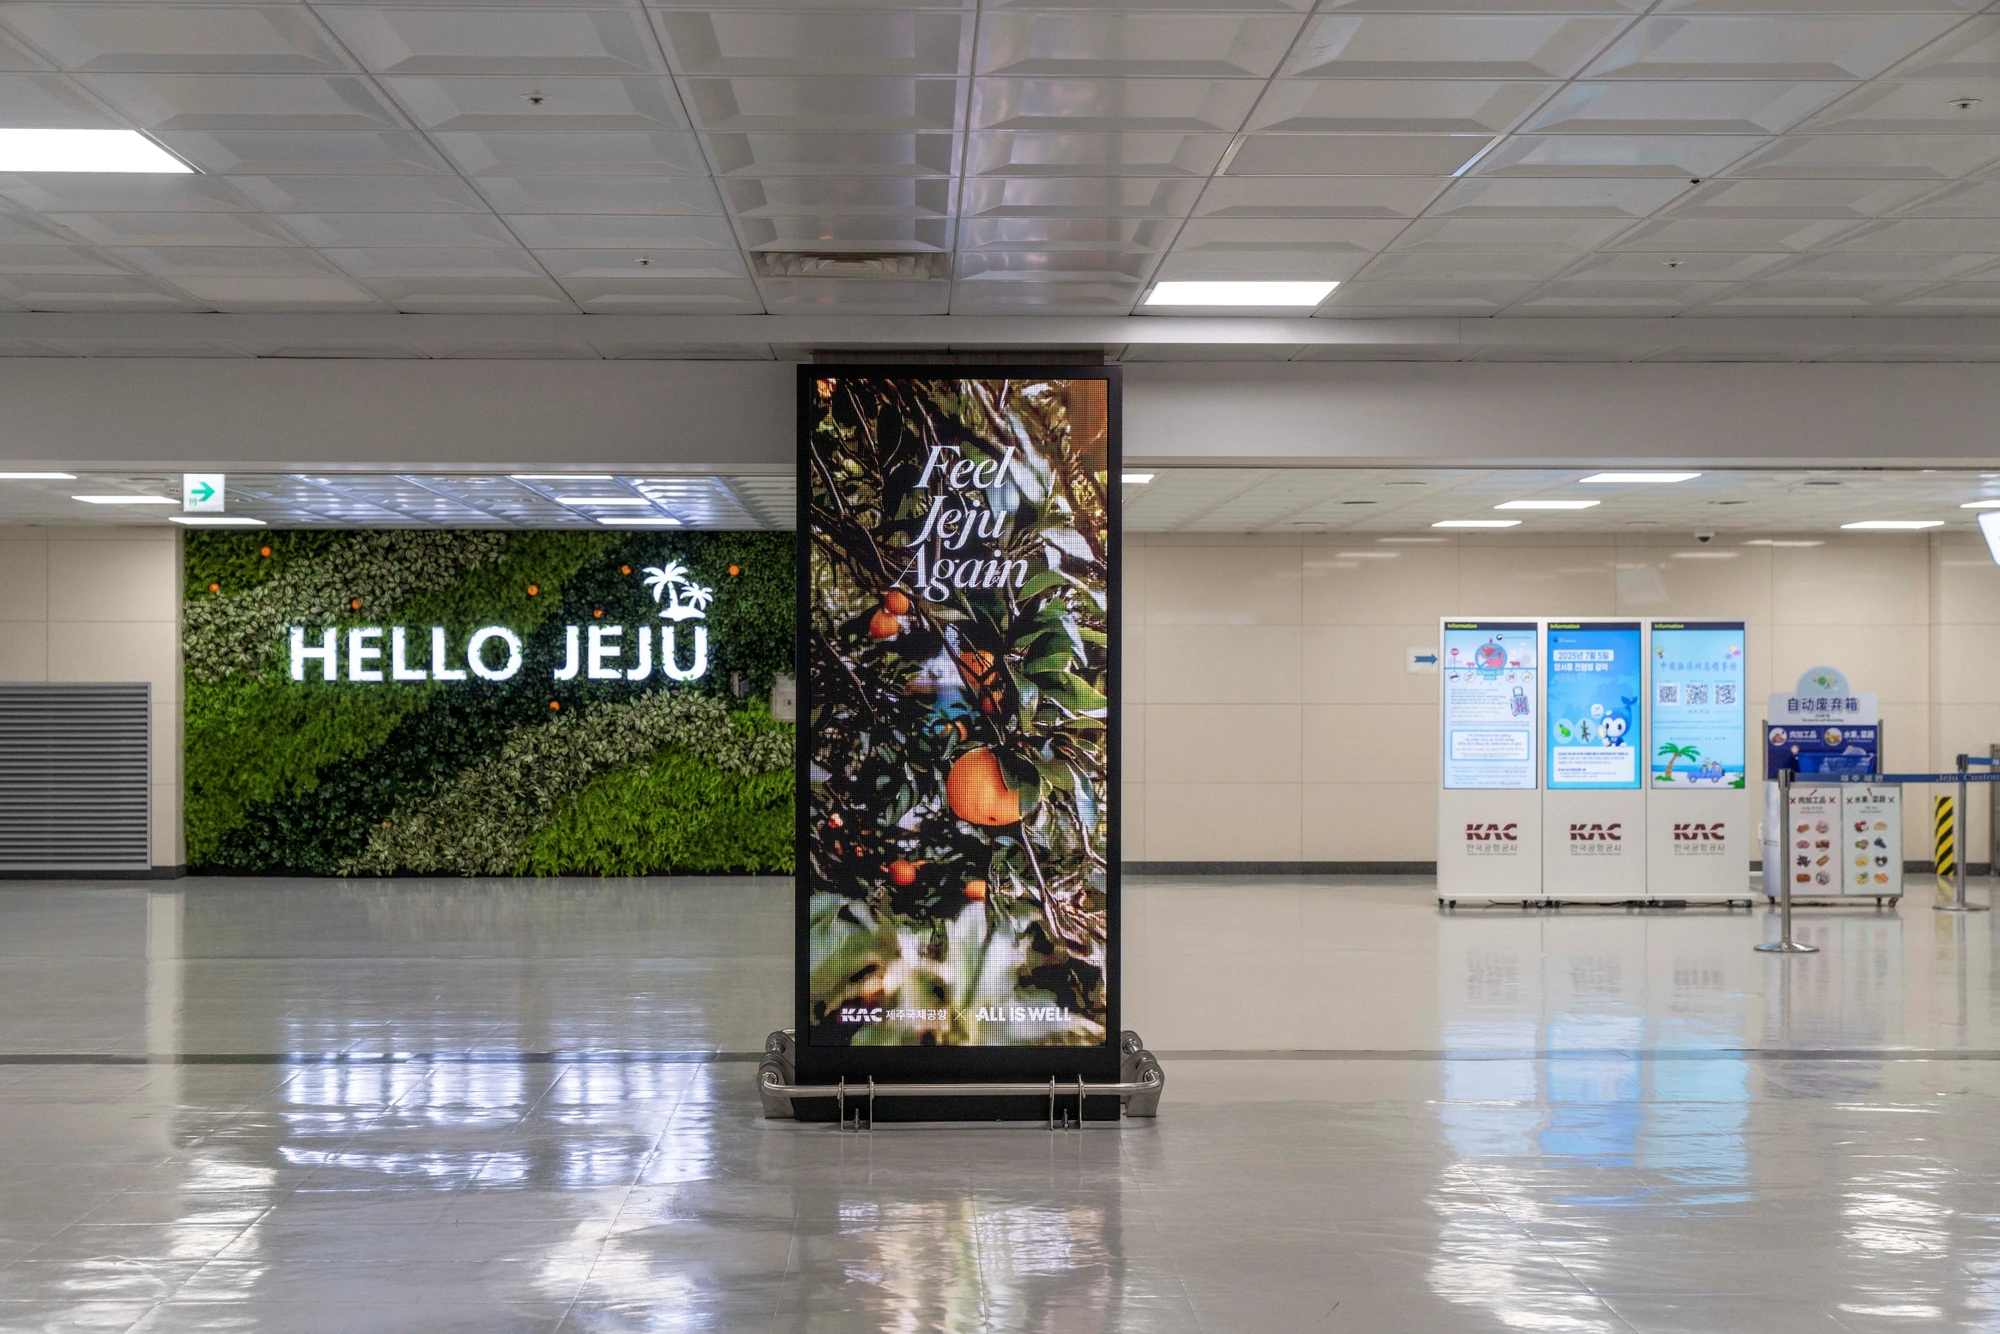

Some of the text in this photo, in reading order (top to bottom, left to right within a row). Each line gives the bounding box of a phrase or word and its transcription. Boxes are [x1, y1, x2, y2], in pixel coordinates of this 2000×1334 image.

[913, 445, 1016, 489] Feel
[906, 495, 1007, 550] Jeju
[890, 544, 1029, 602] Again
[290, 625, 708, 682] HELLO JEJU
[1558, 651, 1609, 660] 2025년 7월 5일
[1787, 697, 1858, 712] 自动废弃箱
[1936, 774, 1958, 782] Jeju
[1798, 796, 1826, 804] 肉加工品
[1465, 823, 1518, 841] KAC
[1569, 823, 1622, 841] KAC
[1672, 823, 1725, 841] KAC
[840, 1007, 883, 1022] KAC
[885, 1008, 947, 1021] 제주국제공항
[975, 1006, 1072, 1022] ALL IS WELL
